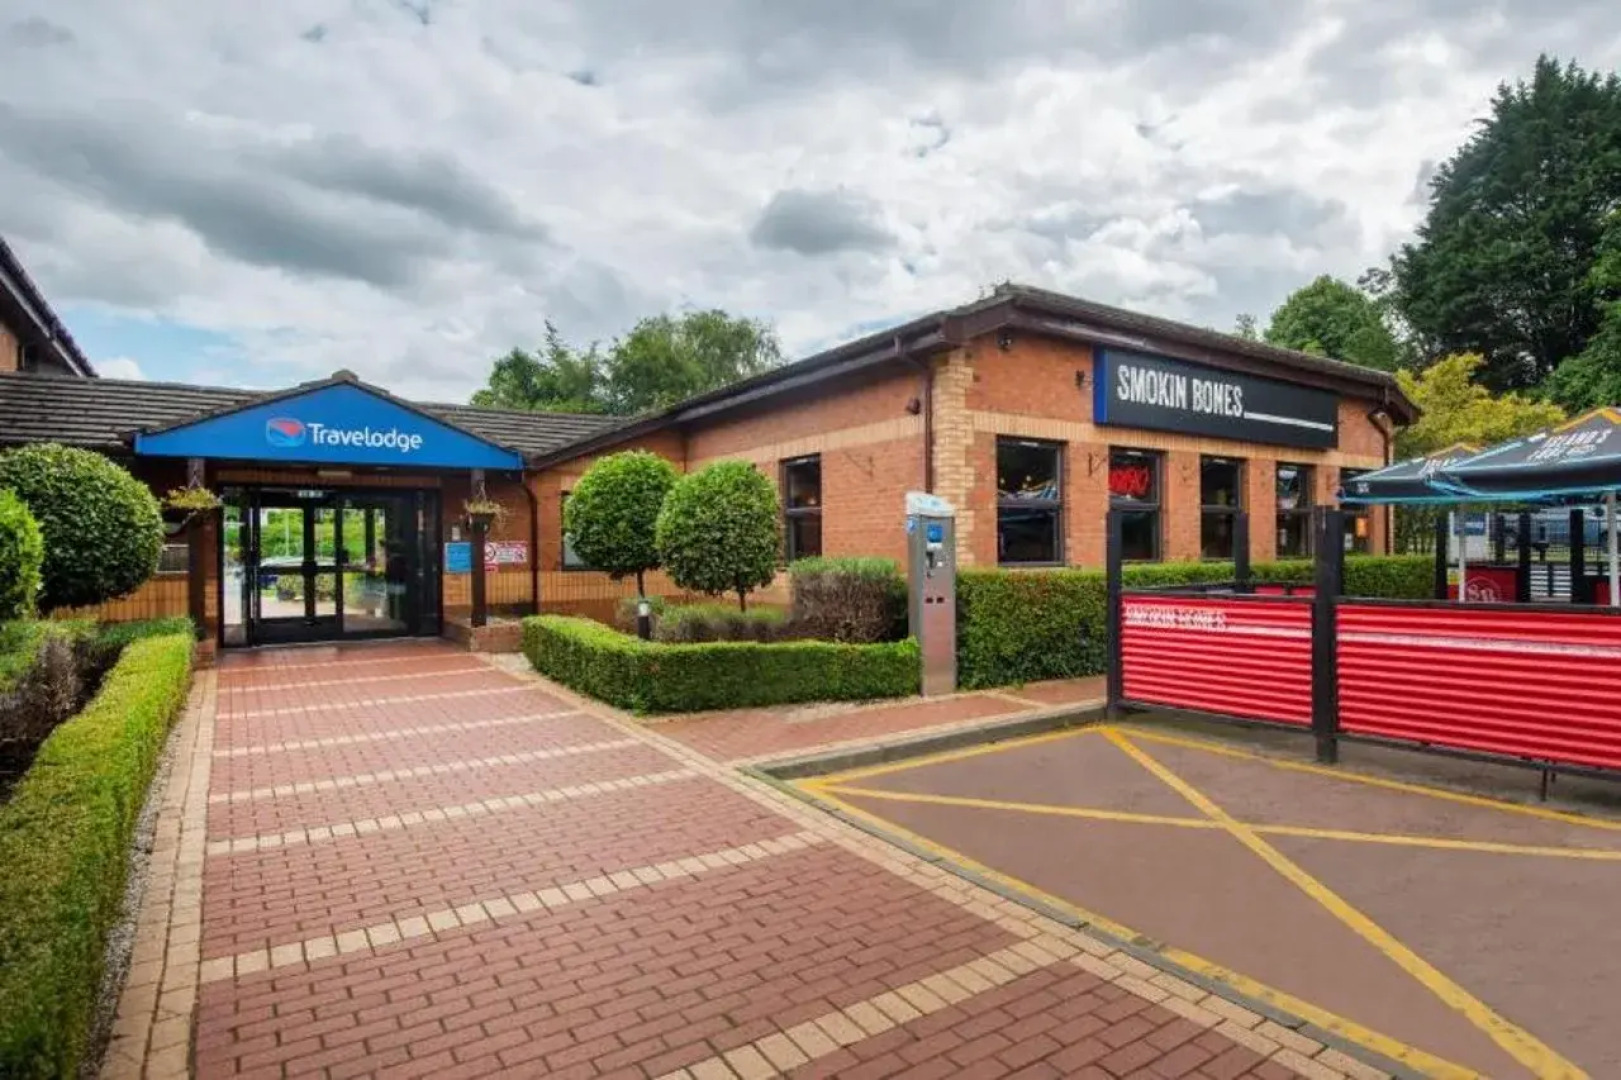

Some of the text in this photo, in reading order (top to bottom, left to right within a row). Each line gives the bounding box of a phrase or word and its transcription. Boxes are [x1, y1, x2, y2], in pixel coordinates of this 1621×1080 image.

[1117, 365, 1244, 417] SMOKIN BONES
[308, 422, 423, 453] Travelodge
